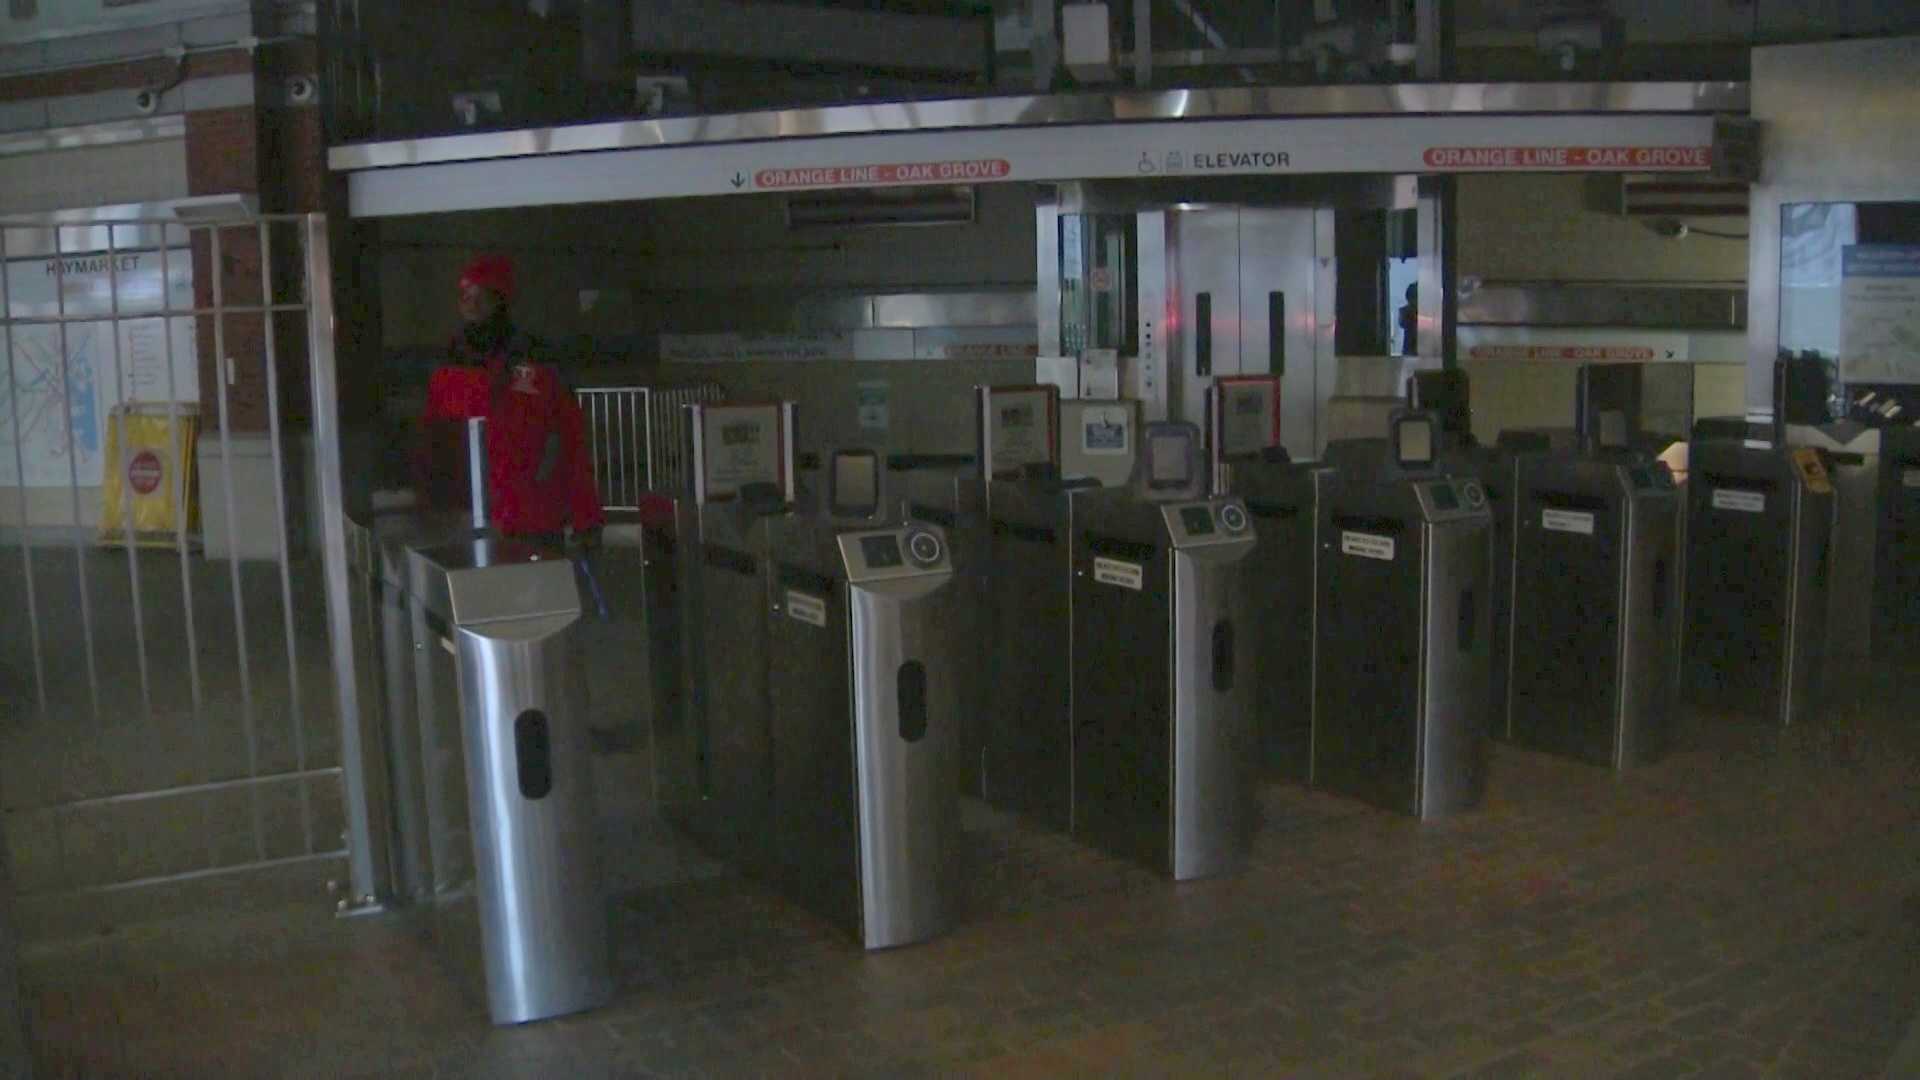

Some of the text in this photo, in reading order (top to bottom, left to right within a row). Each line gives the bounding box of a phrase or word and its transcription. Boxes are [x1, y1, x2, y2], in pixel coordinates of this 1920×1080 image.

[1193, 151, 1290, 169] ELEVATOR
[1432, 149, 1518, 165] ORANGE
[1523, 149, 1568, 165] LINE
[1586, 149, 1630, 165] OAK
[1635, 149, 1708, 165] GROVE
[763, 168, 835, 187] ORANGE
[840, 166, 882, 183] LINE
[897, 163, 935, 180] OAK
[940, 160, 1002, 179] GROVE
